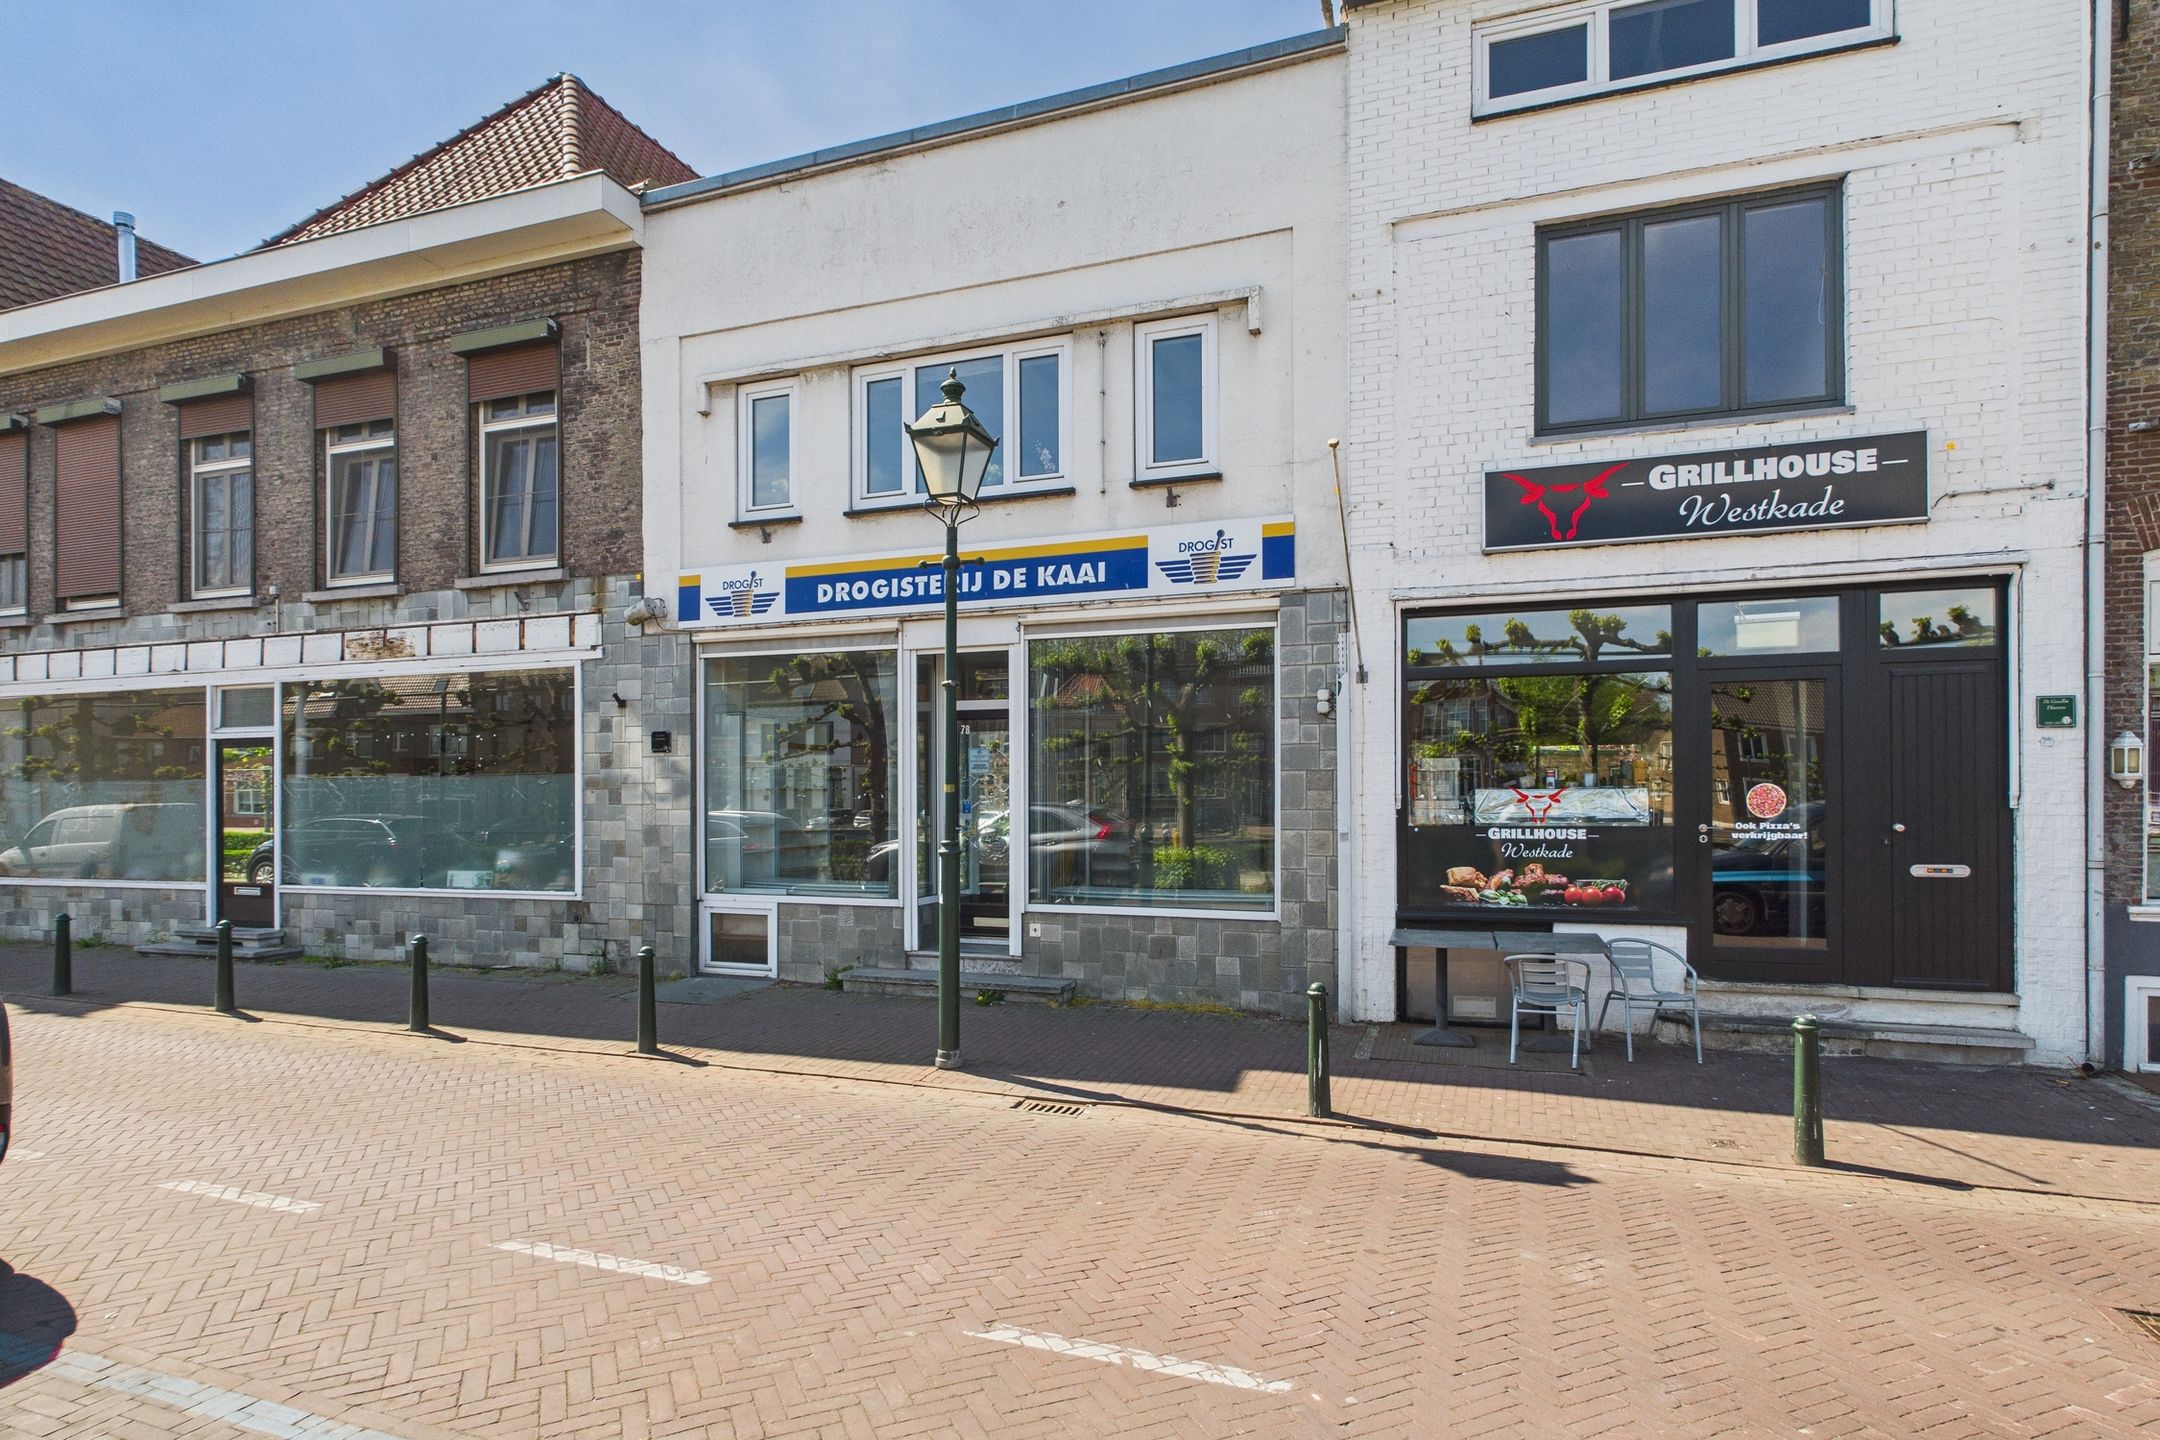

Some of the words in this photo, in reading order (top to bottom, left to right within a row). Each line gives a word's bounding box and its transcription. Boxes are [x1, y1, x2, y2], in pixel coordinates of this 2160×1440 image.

[1648, 447, 1878, 491] GRILLHOUSE
[1679, 485, 1845, 527] Westkade
[1178, 532, 1233, 553] DROGIST
[993, 567, 1027, 590] DE
[1037, 561, 1106, 587] KAAI
[960, 724, 971, 735] 78
[1487, 827, 1587, 840] GRILLHOUSE
[1735, 822, 1757, 830] Ook
[1501, 842, 1573, 858] Westkade
